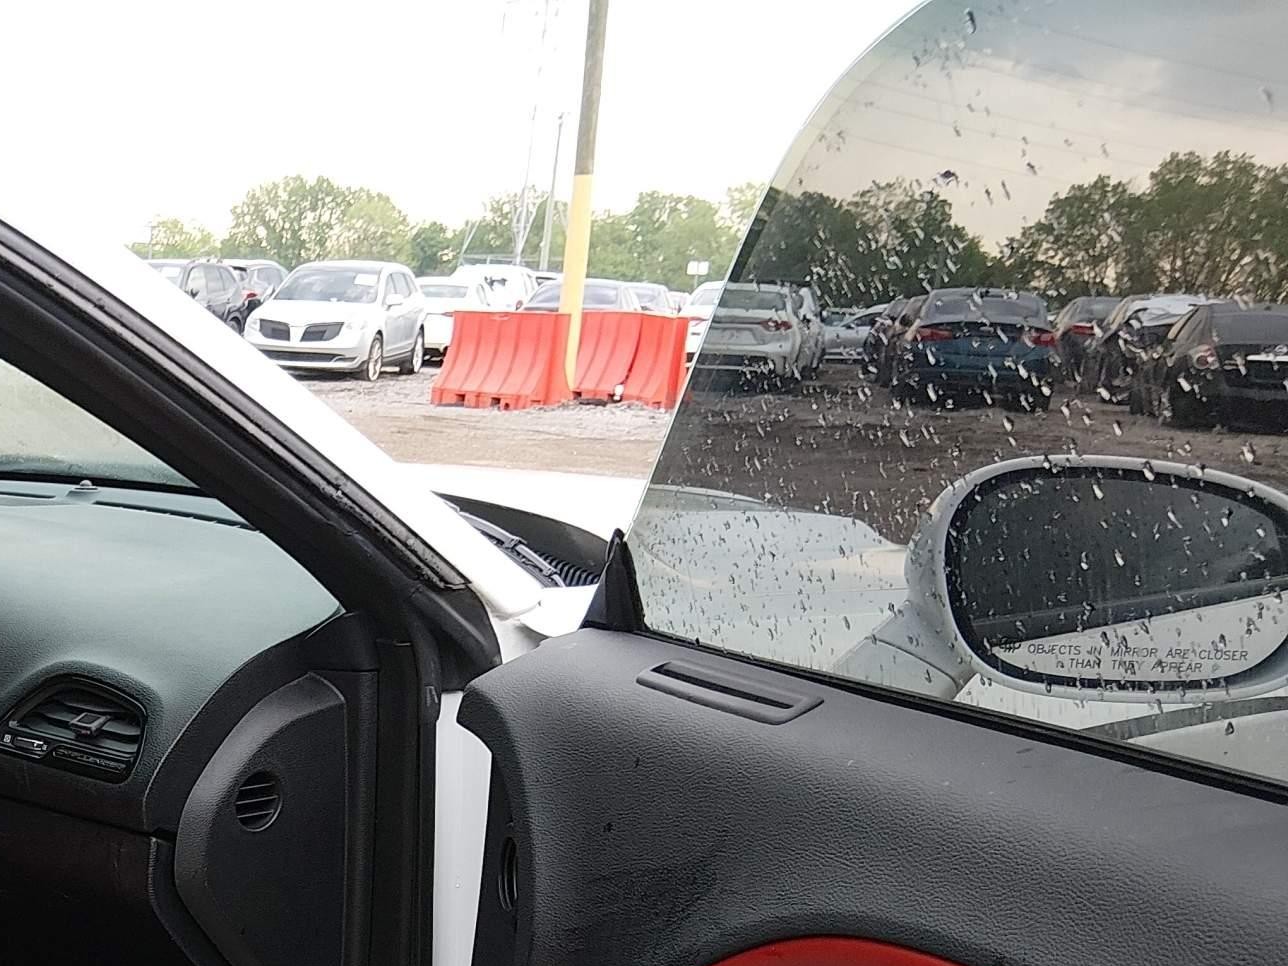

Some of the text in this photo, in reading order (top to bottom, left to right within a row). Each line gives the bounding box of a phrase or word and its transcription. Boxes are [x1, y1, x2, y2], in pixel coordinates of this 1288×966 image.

[1027, 643, 1249, 661] OBJECTS IN MIRROR ARE CLOSER
[1068, 657, 1102, 669] THAN
[1151, 660, 1203, 673] APPEAR
